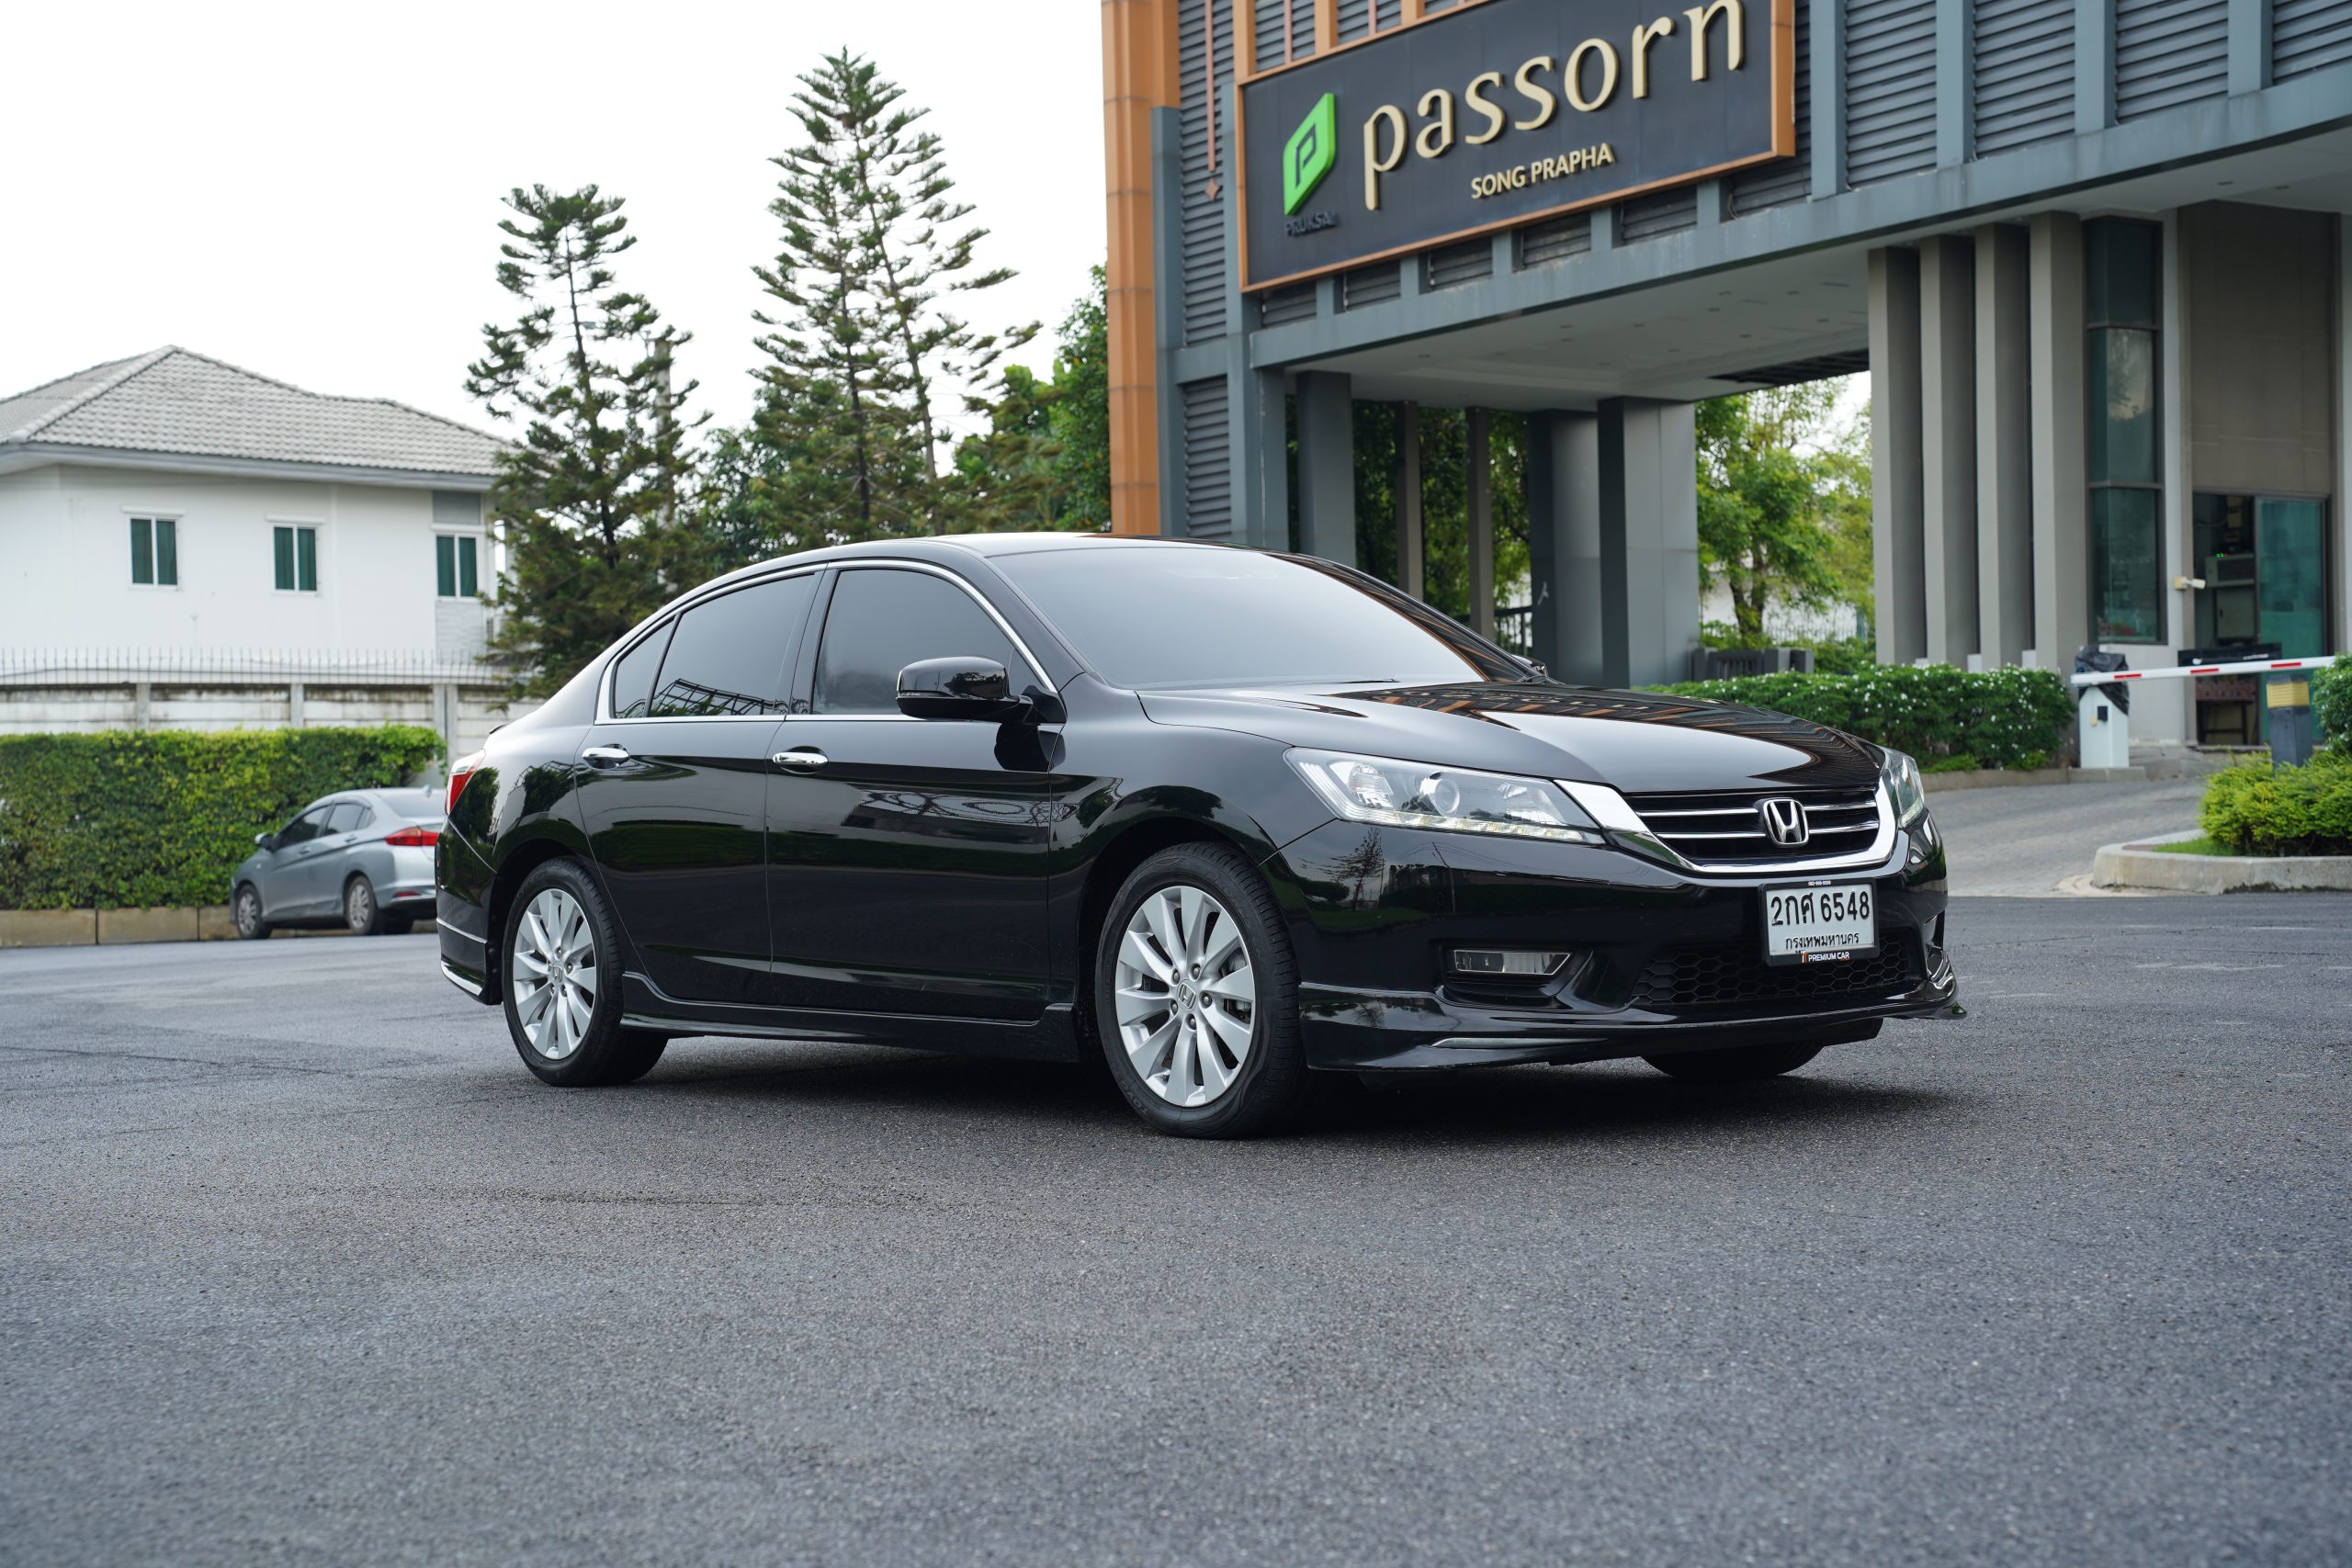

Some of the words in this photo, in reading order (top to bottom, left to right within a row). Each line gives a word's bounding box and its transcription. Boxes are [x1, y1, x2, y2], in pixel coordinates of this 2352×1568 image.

[1363, 0, 1744, 210] passorn
[1471, 165, 1526, 199] SONG
[1531, 142, 1615, 184] PRAPHA
[1820, 890, 1871, 922] 6548
[1786, 932, 1860, 951] กรุงเทพมหานคร
[1808, 952, 1837, 963] PREMIUM
[1837, 951, 1850, 961] CAR
